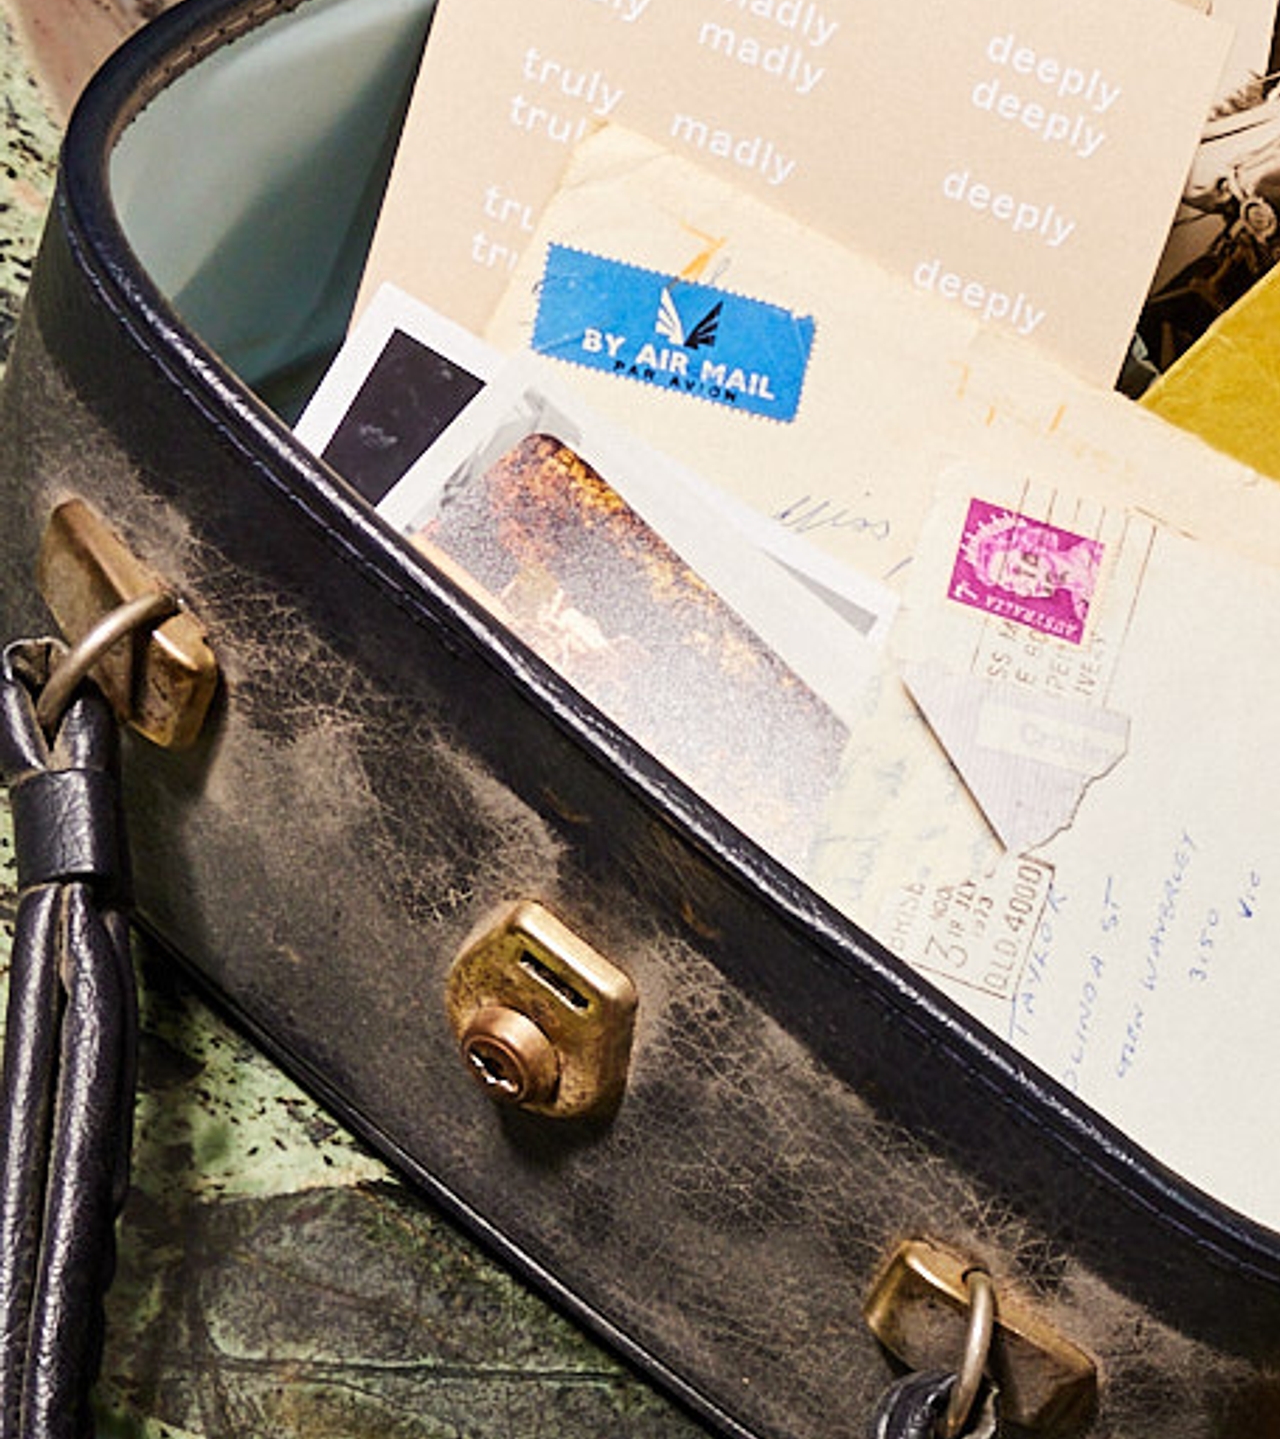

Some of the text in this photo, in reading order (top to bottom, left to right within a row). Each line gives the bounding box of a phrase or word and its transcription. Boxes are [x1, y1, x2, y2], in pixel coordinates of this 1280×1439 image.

[698, 18, 827, 96] madly
[985, 32, 1122, 112] deeply
[522, 46, 797, 187] truly madly
[971, 79, 1107, 159] deeply
[942, 168, 1076, 249] deeply
[912, 259, 1046, 335] deeply
[582, 327, 775, 401] BY AIR MAIL
[613, 361, 737, 403] PAR AVION
[985, 596, 1078, 635] AUSTRALIA
